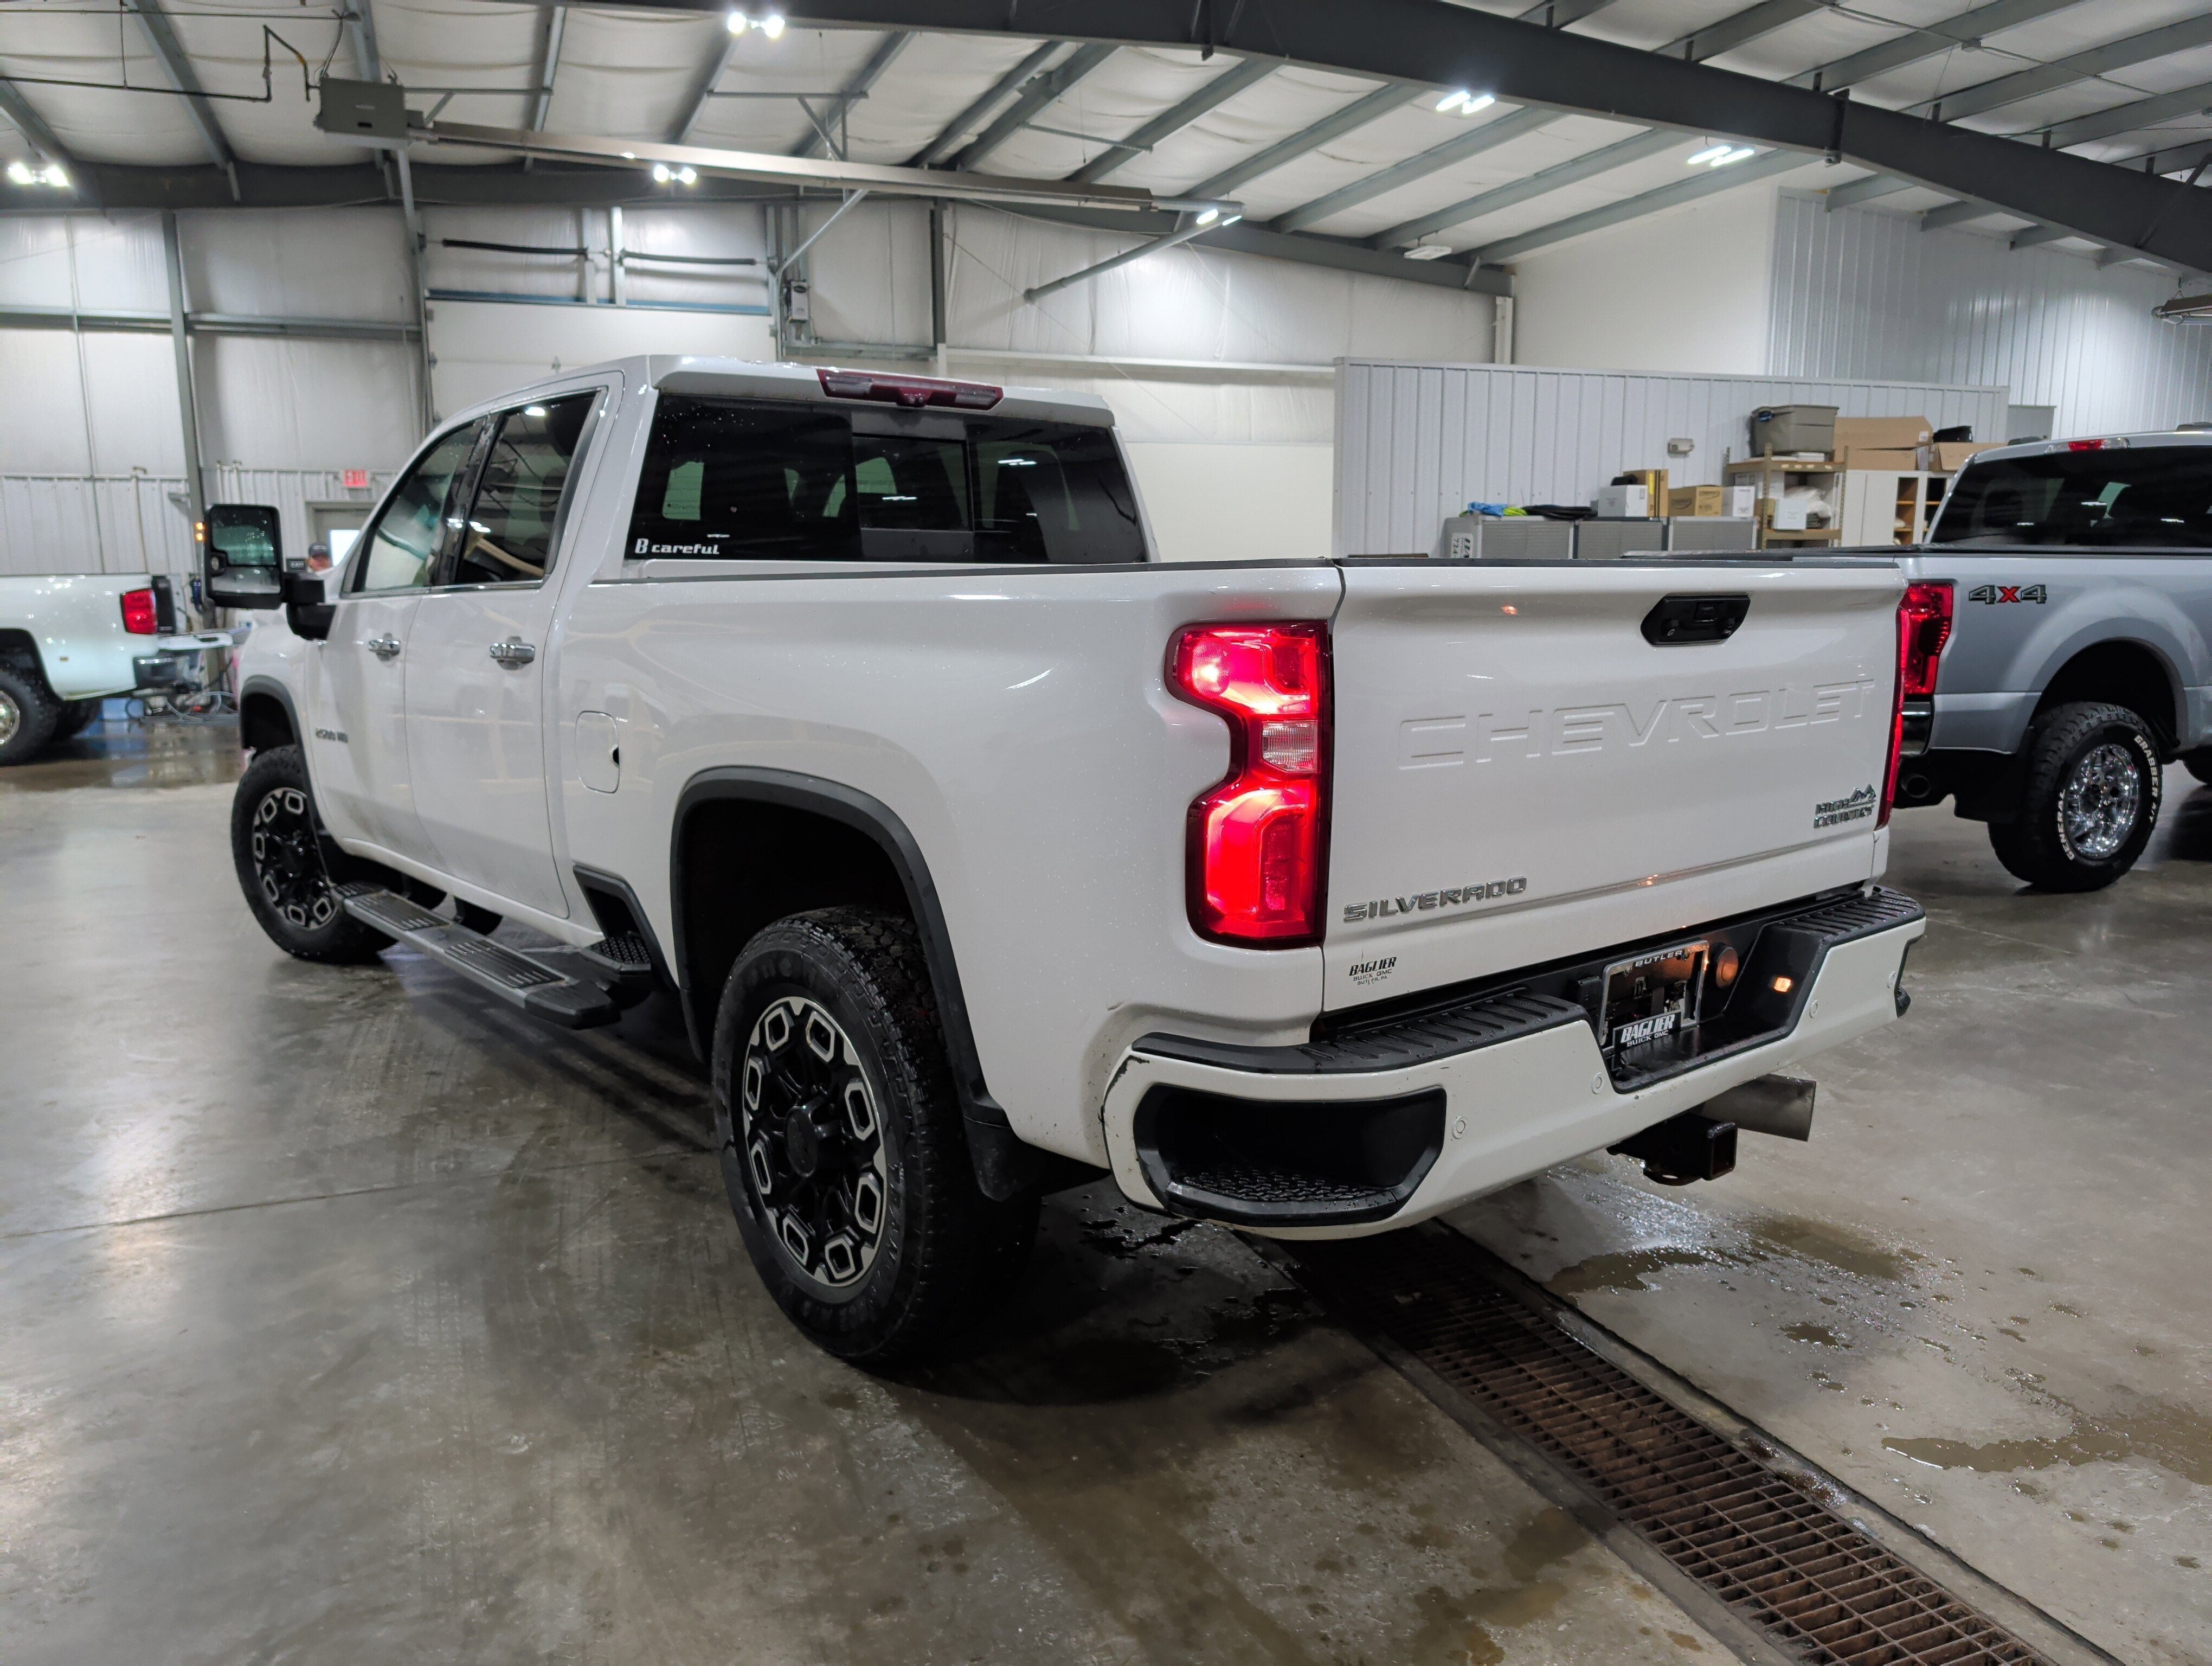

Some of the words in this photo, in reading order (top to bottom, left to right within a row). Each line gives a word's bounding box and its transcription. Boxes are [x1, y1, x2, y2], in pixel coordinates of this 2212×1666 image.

[344, 469, 367, 487] EXIT
[635, 538, 649, 554] B
[651, 544, 720, 555] careful
[1399, 679, 1876, 771] CHEVROLET
[2134, 734, 2158, 798] GRABBER
[1815, 798, 1849, 815] HIGH
[1814, 805, 1875, 829] COUNTRY
[2057, 788, 2075, 861] GENERAL
[1343, 875, 1527, 923] SILVERADO
[1349, 957, 1397, 976] BAGLIER
[1635, 950, 1682, 967] BUTLER
[1353, 973, 1373, 981] BUICK
[1620, 1014, 1675, 1043] BAGLIER
[1626, 1035, 1652, 1047] BUICK
[1654, 1030, 1668, 1039] GMC
